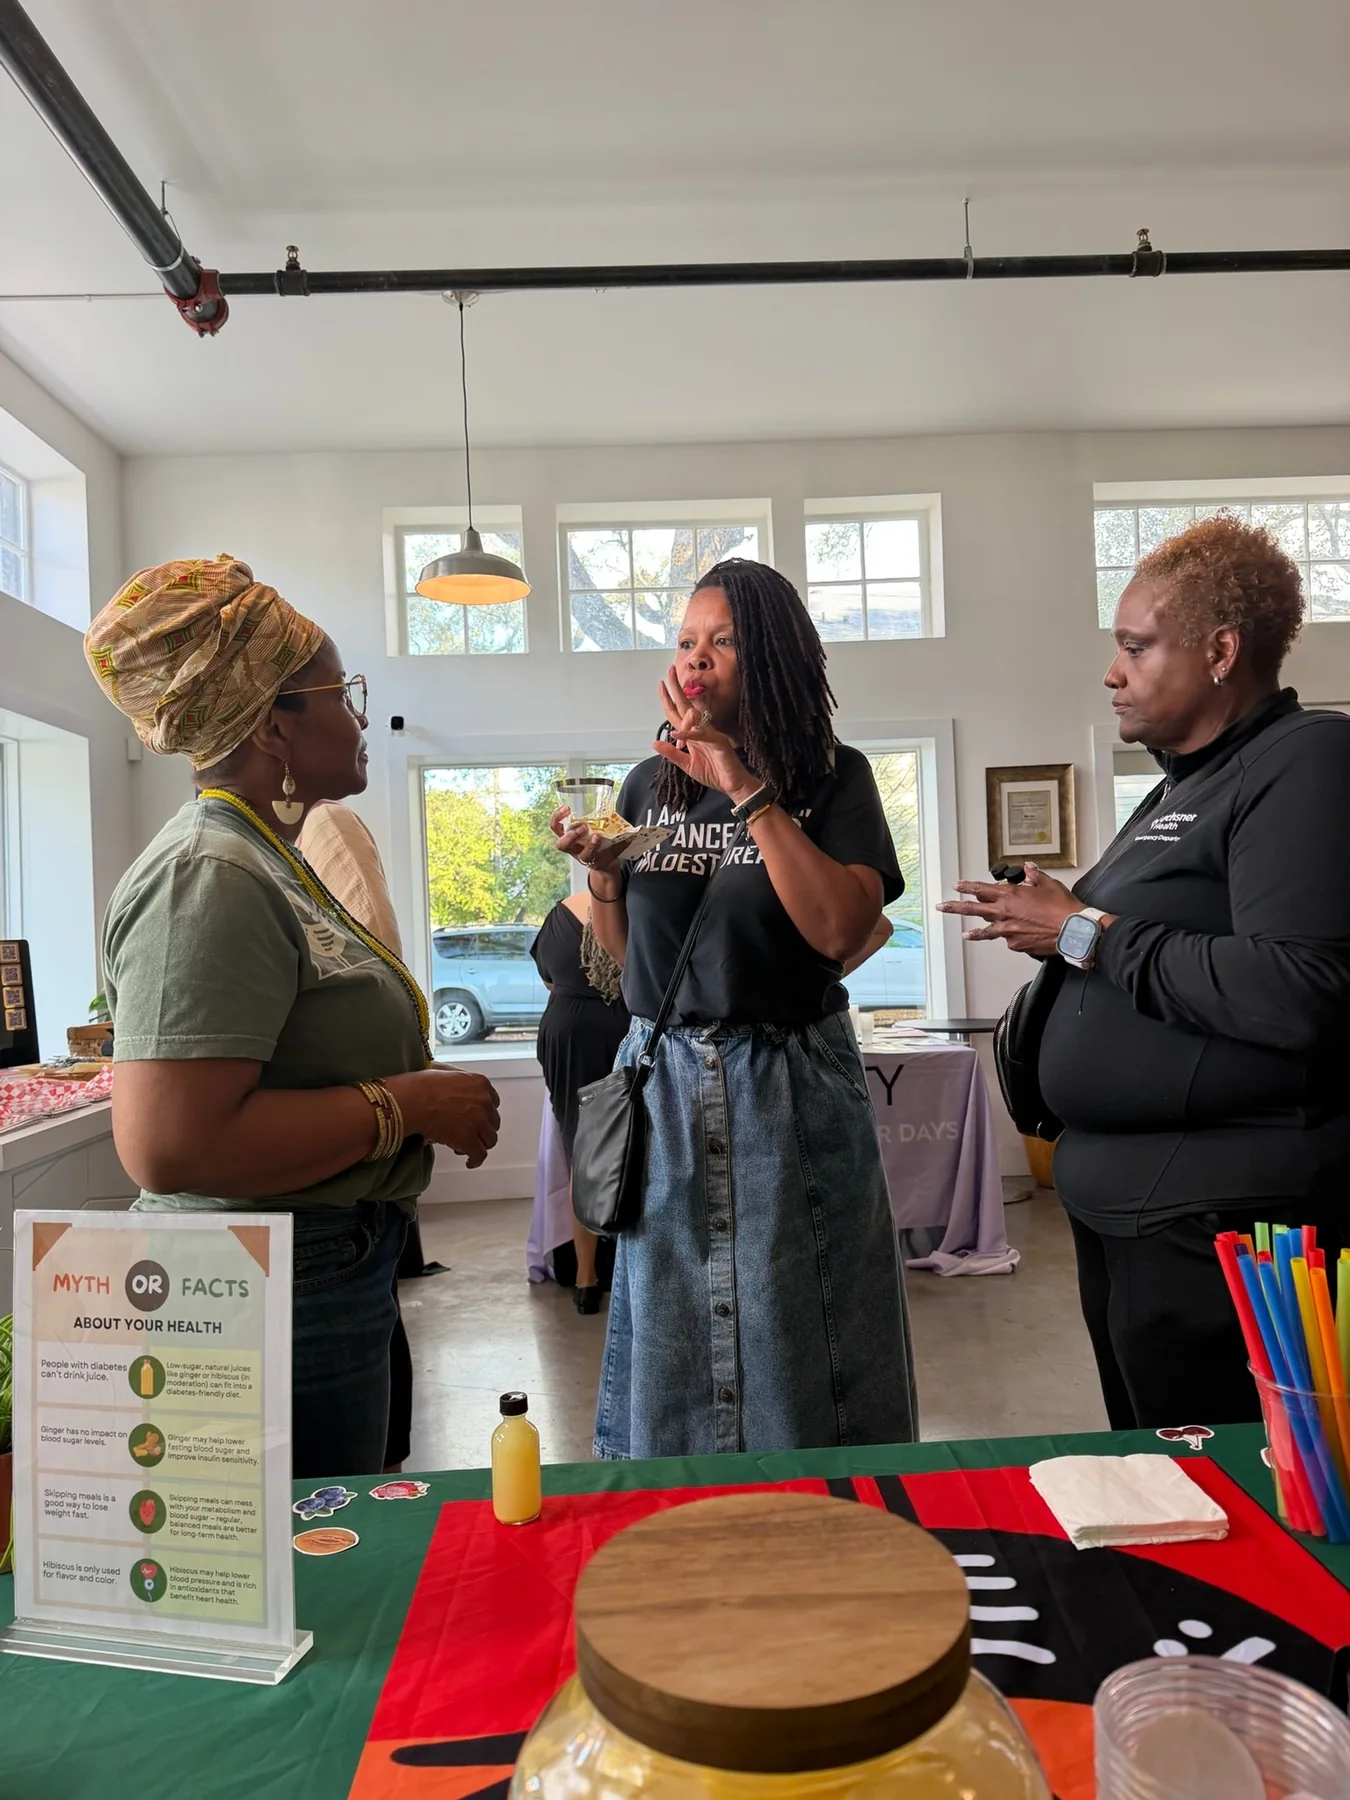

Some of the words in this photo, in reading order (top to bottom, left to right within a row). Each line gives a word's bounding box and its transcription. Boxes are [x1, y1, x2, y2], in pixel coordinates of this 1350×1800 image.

[646, 809, 652, 828] I
[899, 1120, 959, 1143] DAYS
[53, 1273, 110, 1294] MYTH
[132, 1275, 163, 1294] OR
[182, 1278, 249, 1298] FACTS
[74, 1317, 121, 1330] ABOUT
[124, 1318, 163, 1332] YOUR
[168, 1321, 222, 1334] HEALTH
[41, 1360, 69, 1369] People
[71, 1361, 89, 1369] with
[90, 1362, 128, 1371] diabetes
[166, 1362, 204, 1370] Low-sugar,
[41, 1370, 62, 1378] can't
[64, 1371, 85, 1379] drink
[85, 1373, 108, 1381] juice.
[166, 1380, 208, 1389] moderation)
[166, 1388, 225, 1398] diabetes-friendly
[41, 1426, 64, 1434] Ginger
[91, 1429, 116, 1437] impact
[168, 1434, 191, 1442] Ginger
[192, 1436, 207, 1444] may
[209, 1437, 224, 1445] help
[168, 1444, 192, 1452] fasting
[194, 1445, 213, 1453] blood
[215, 1447, 234, 1455] sugar
[168, 1453, 196, 1461] improve
[198, 1454, 220, 1462] insulin
[221, 1457, 259, 1466] sensitivity.
[44, 1489, 77, 1500] Skipping
[79, 1492, 101, 1500] meals
[169, 1494, 198, 1503] Skipping
[200, 1496, 219, 1504] meals
[92, 1503, 108, 1511] lose
[202, 1506, 241, 1514] metabolism
[44, 1509, 70, 1518] weight
[72, 1511, 89, 1519] fast.
[216, 1516, 243, 1524] regular,
[170, 1521, 200, 1529] balanced
[202, 1523, 222, 1531] meals
[236, 1525, 257, 1533] better
[181, 1530, 215, 1539] long-term
[216, 1533, 240, 1541] health.
[43, 1561, 75, 1571] Hibiscus
[76, 1564, 82, 1572] is
[84, 1565, 100, 1574] only
[101, 1567, 120, 1575] used
[170, 1566, 198, 1575] Hibiscus
[200, 1569, 214, 1577] may
[215, 1570, 230, 1578] help
[231, 1571, 250, 1580] lower
[56, 1572, 77, 1580] flavor
[95, 1576, 118, 1585] color.
[190, 1578, 220, 1586] pressure
[178, 1584, 220, 1594] antioxidants
[221, 1588, 235, 1596] that
[170, 1593, 194, 1601] benefit
[196, 1595, 214, 1603] heart
[216, 1597, 240, 1605] health.
